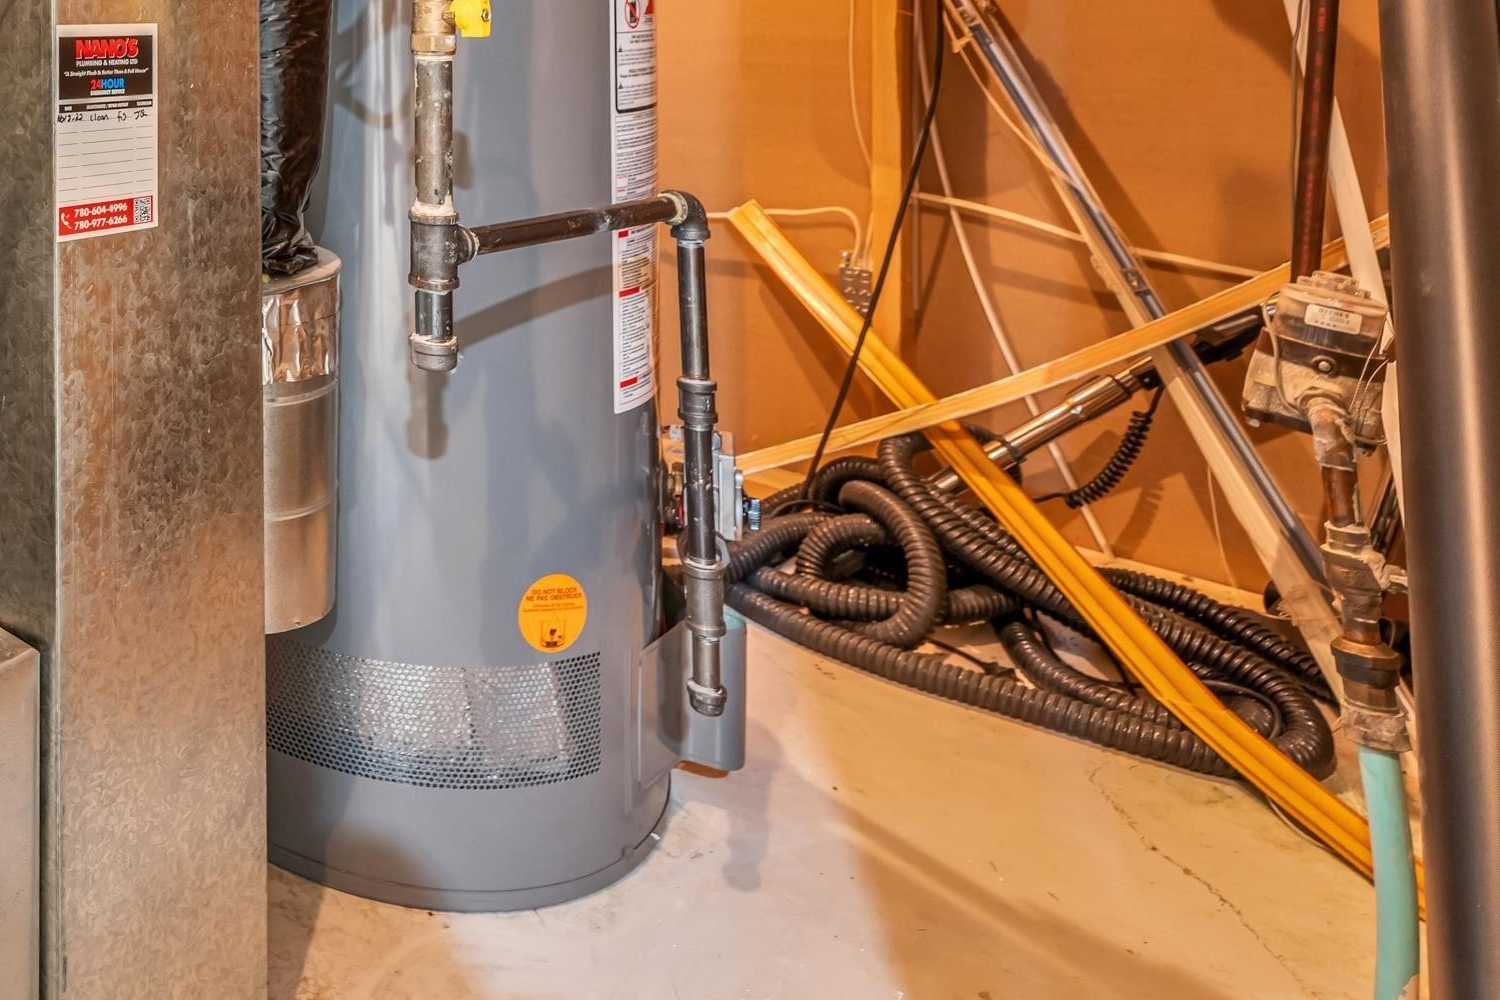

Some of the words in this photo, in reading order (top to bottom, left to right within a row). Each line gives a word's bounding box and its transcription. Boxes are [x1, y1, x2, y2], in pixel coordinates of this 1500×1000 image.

[75, 38, 139, 60] NANO'S
[75, 59, 102, 67] PLUMBING
[74, 203, 128, 218] 780-604-4996
[74, 215, 128, 230] 780-977-6266
